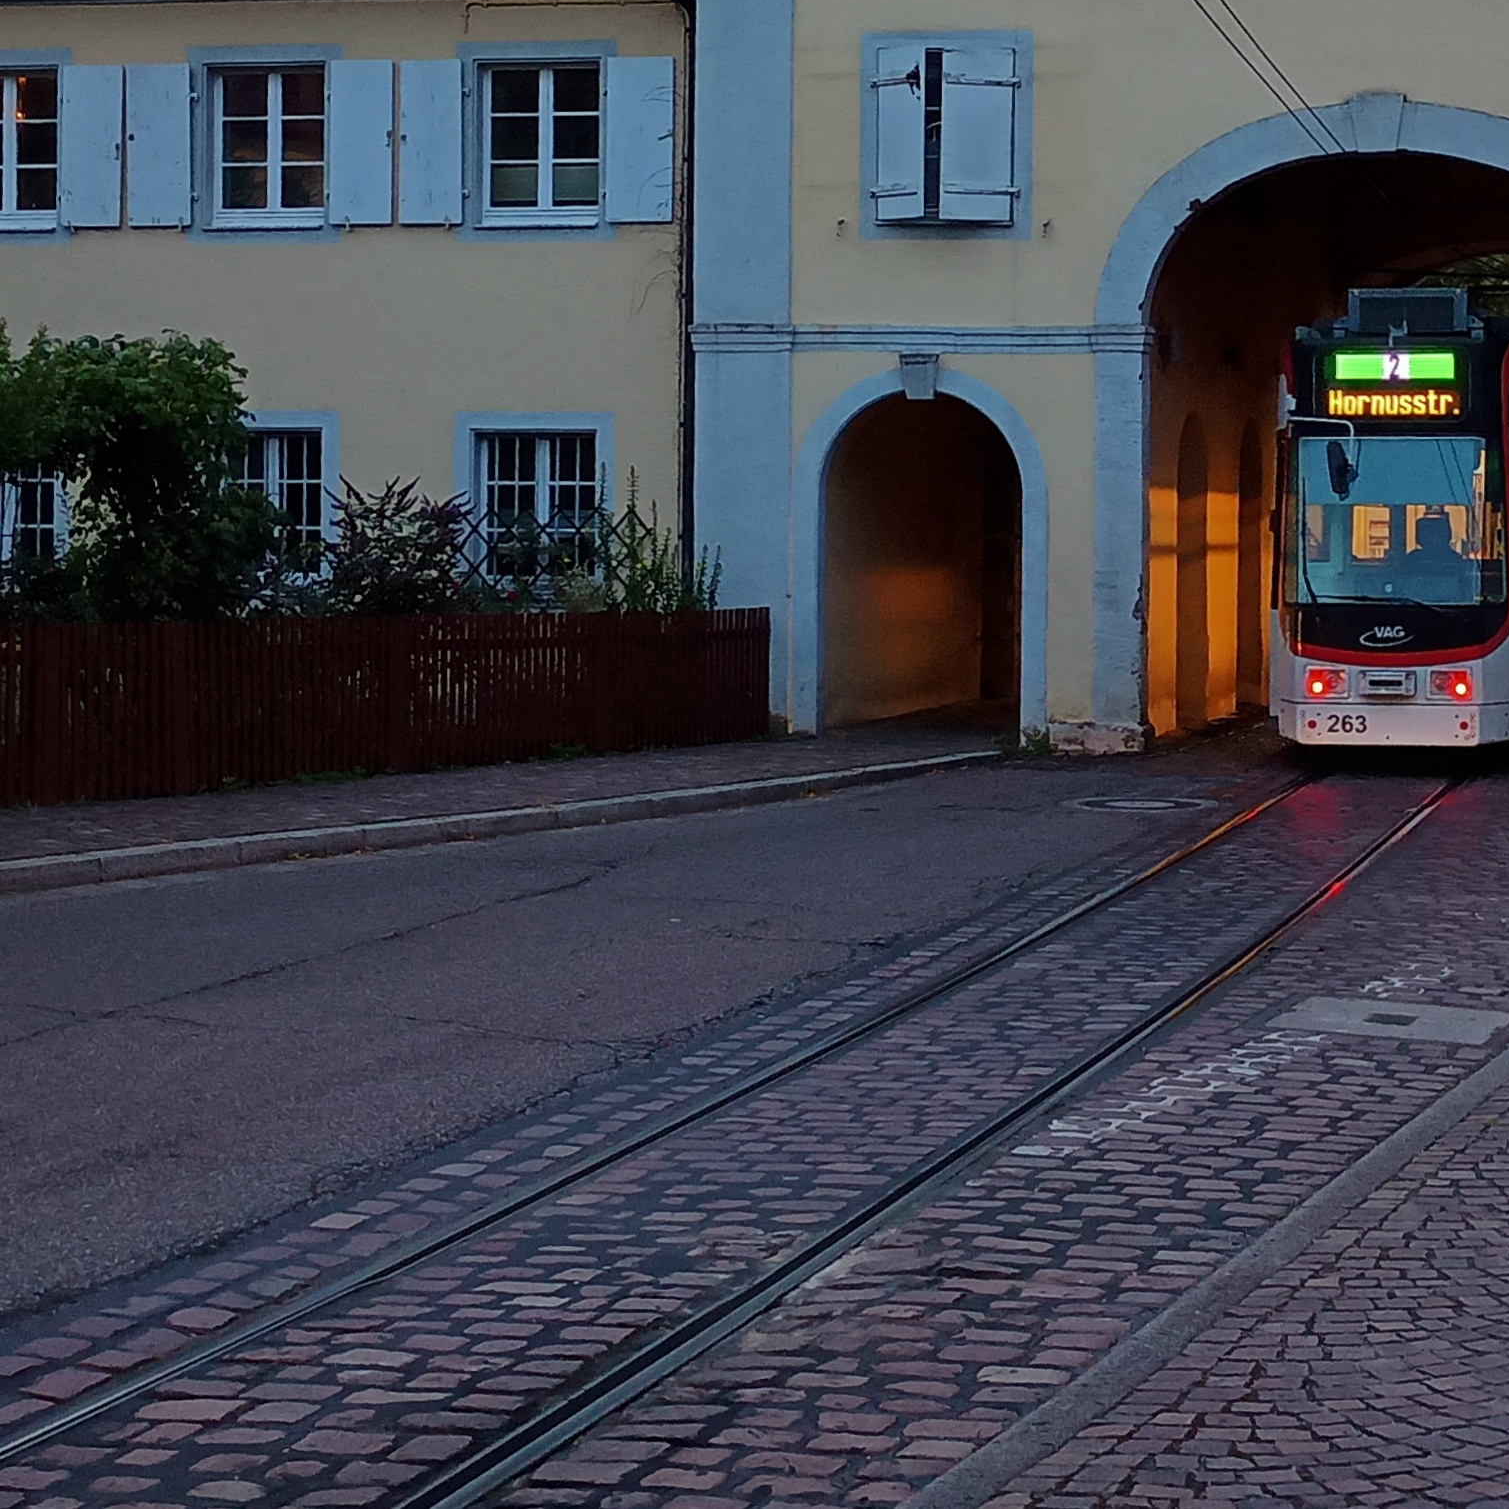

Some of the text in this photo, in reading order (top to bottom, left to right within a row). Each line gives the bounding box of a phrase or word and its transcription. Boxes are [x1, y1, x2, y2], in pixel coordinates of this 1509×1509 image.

[1389, 351, 1401, 381] 2
[1328, 389, 1460, 415] Hornusstr.
[1374, 626, 1406, 638] VAG
[1327, 714, 1368, 734] 263
